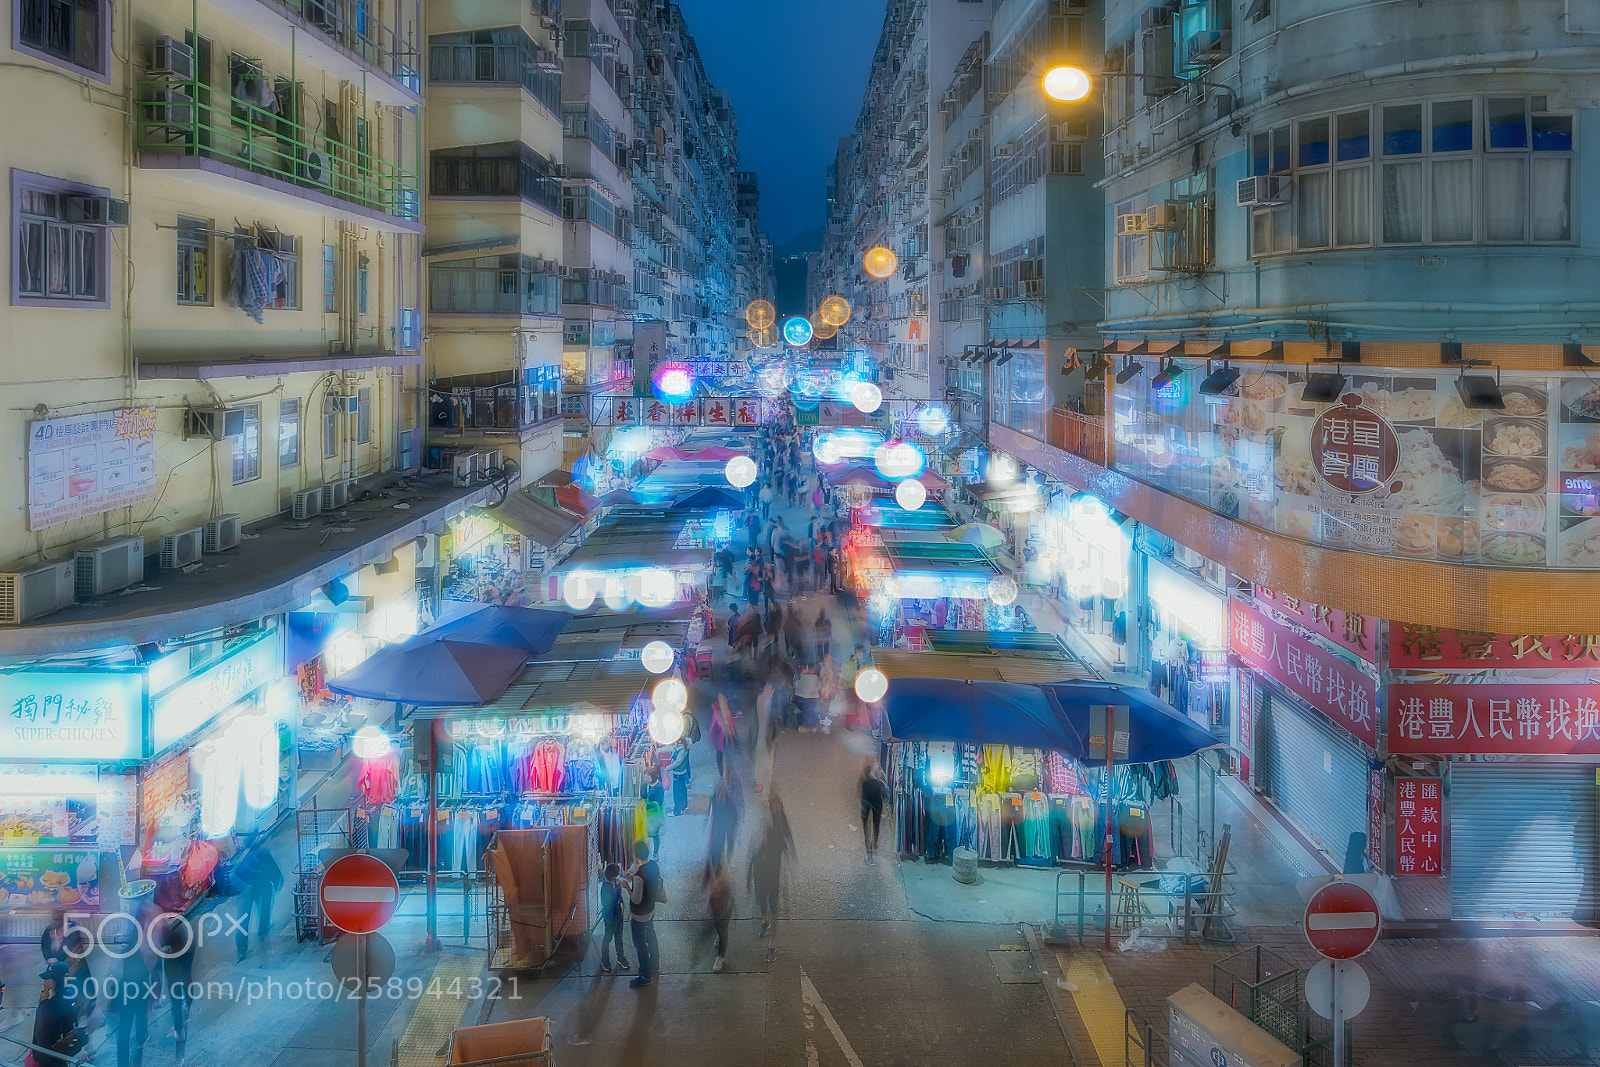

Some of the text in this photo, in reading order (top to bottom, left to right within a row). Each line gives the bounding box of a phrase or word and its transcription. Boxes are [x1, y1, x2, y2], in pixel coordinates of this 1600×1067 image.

[14, 726, 117, 741] SUPER-CHICKEN
[1399, 781, 1417, 872] 港豐人民幣
[1421, 783, 1438, 872] 匯款中心
